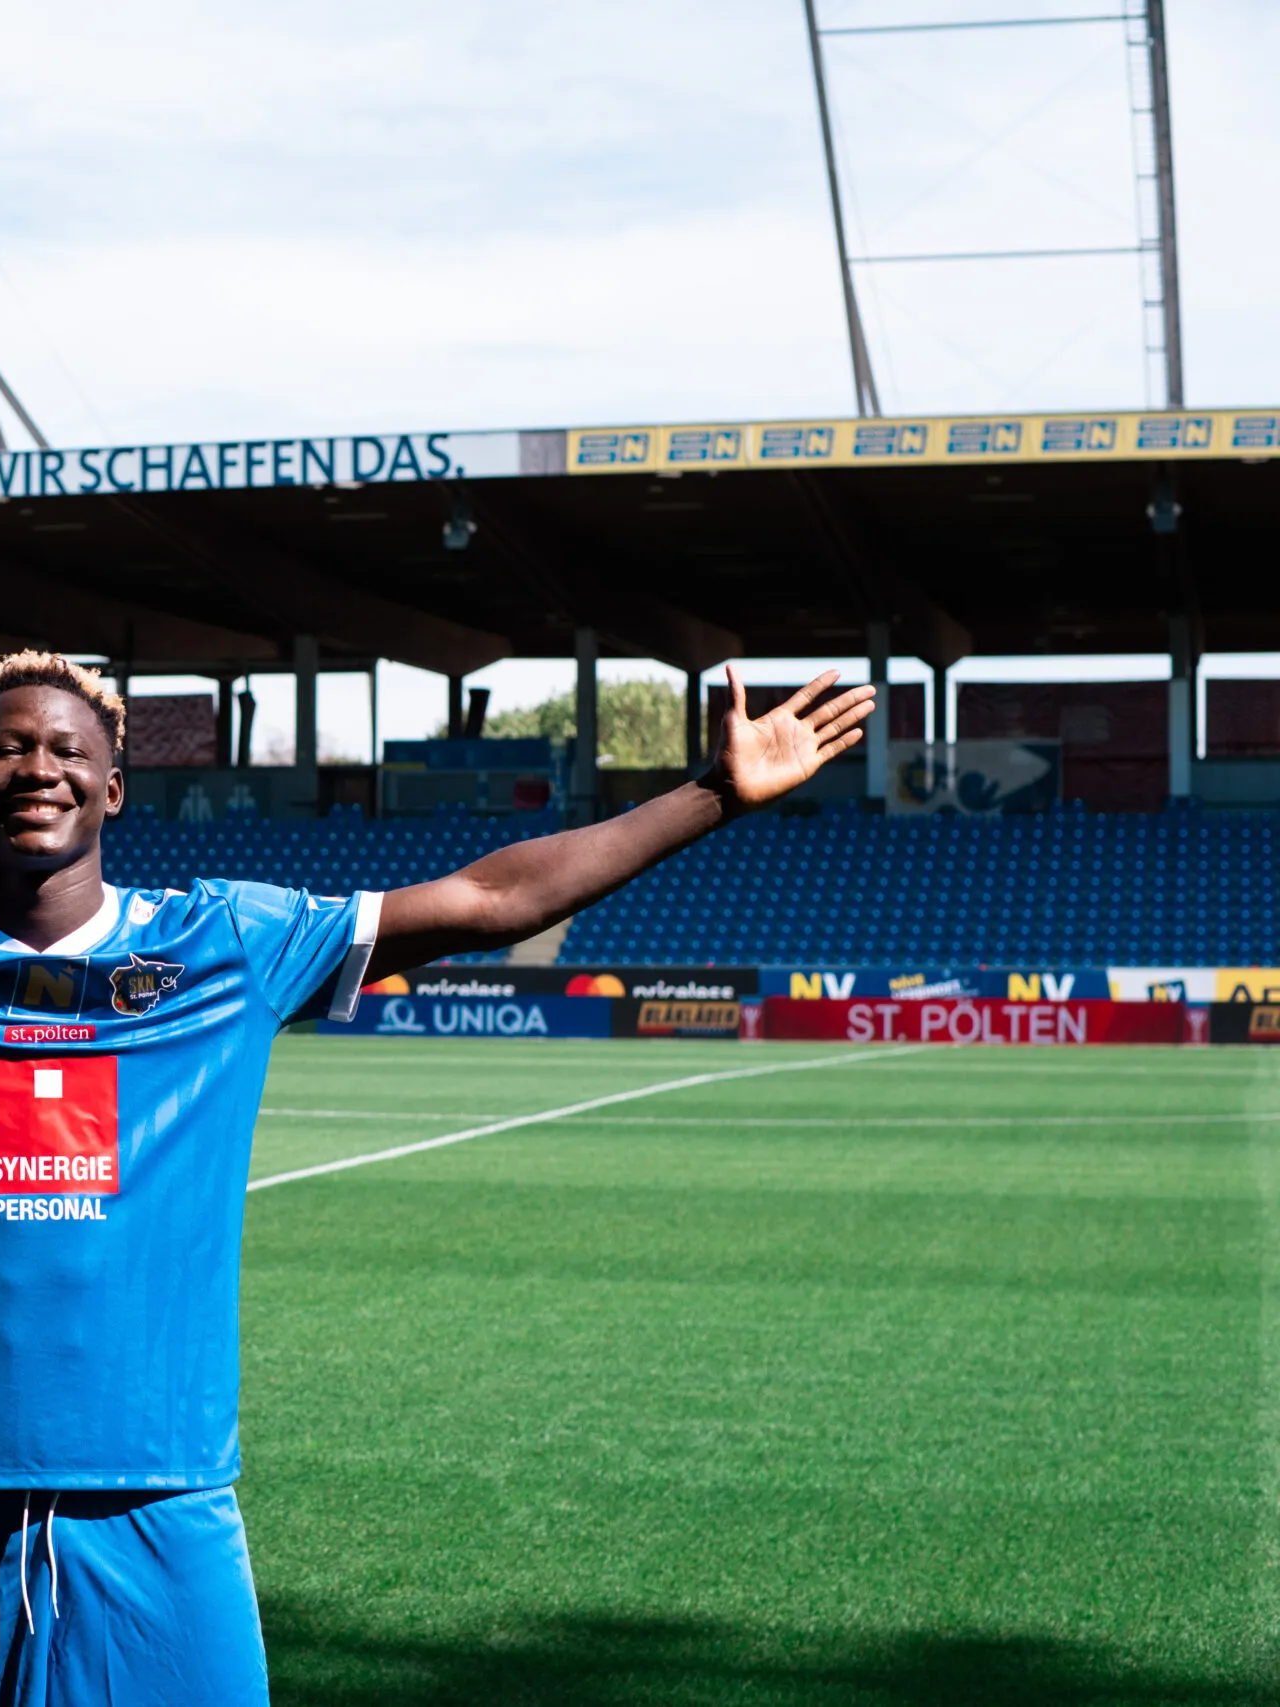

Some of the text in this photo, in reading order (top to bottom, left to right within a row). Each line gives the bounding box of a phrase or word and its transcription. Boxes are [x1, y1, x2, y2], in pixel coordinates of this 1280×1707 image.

[79, 437, 335, 493] SCHAFFEN
[351, 433, 465, 482] DAS.
[128, 972, 155, 993] SKN
[790, 972, 856, 1000] NV
[1008, 973, 1076, 1002] NV
[434, 1003, 548, 1034] UNIQA
[846, 1000, 1087, 1044] ST. PÖLTEN
